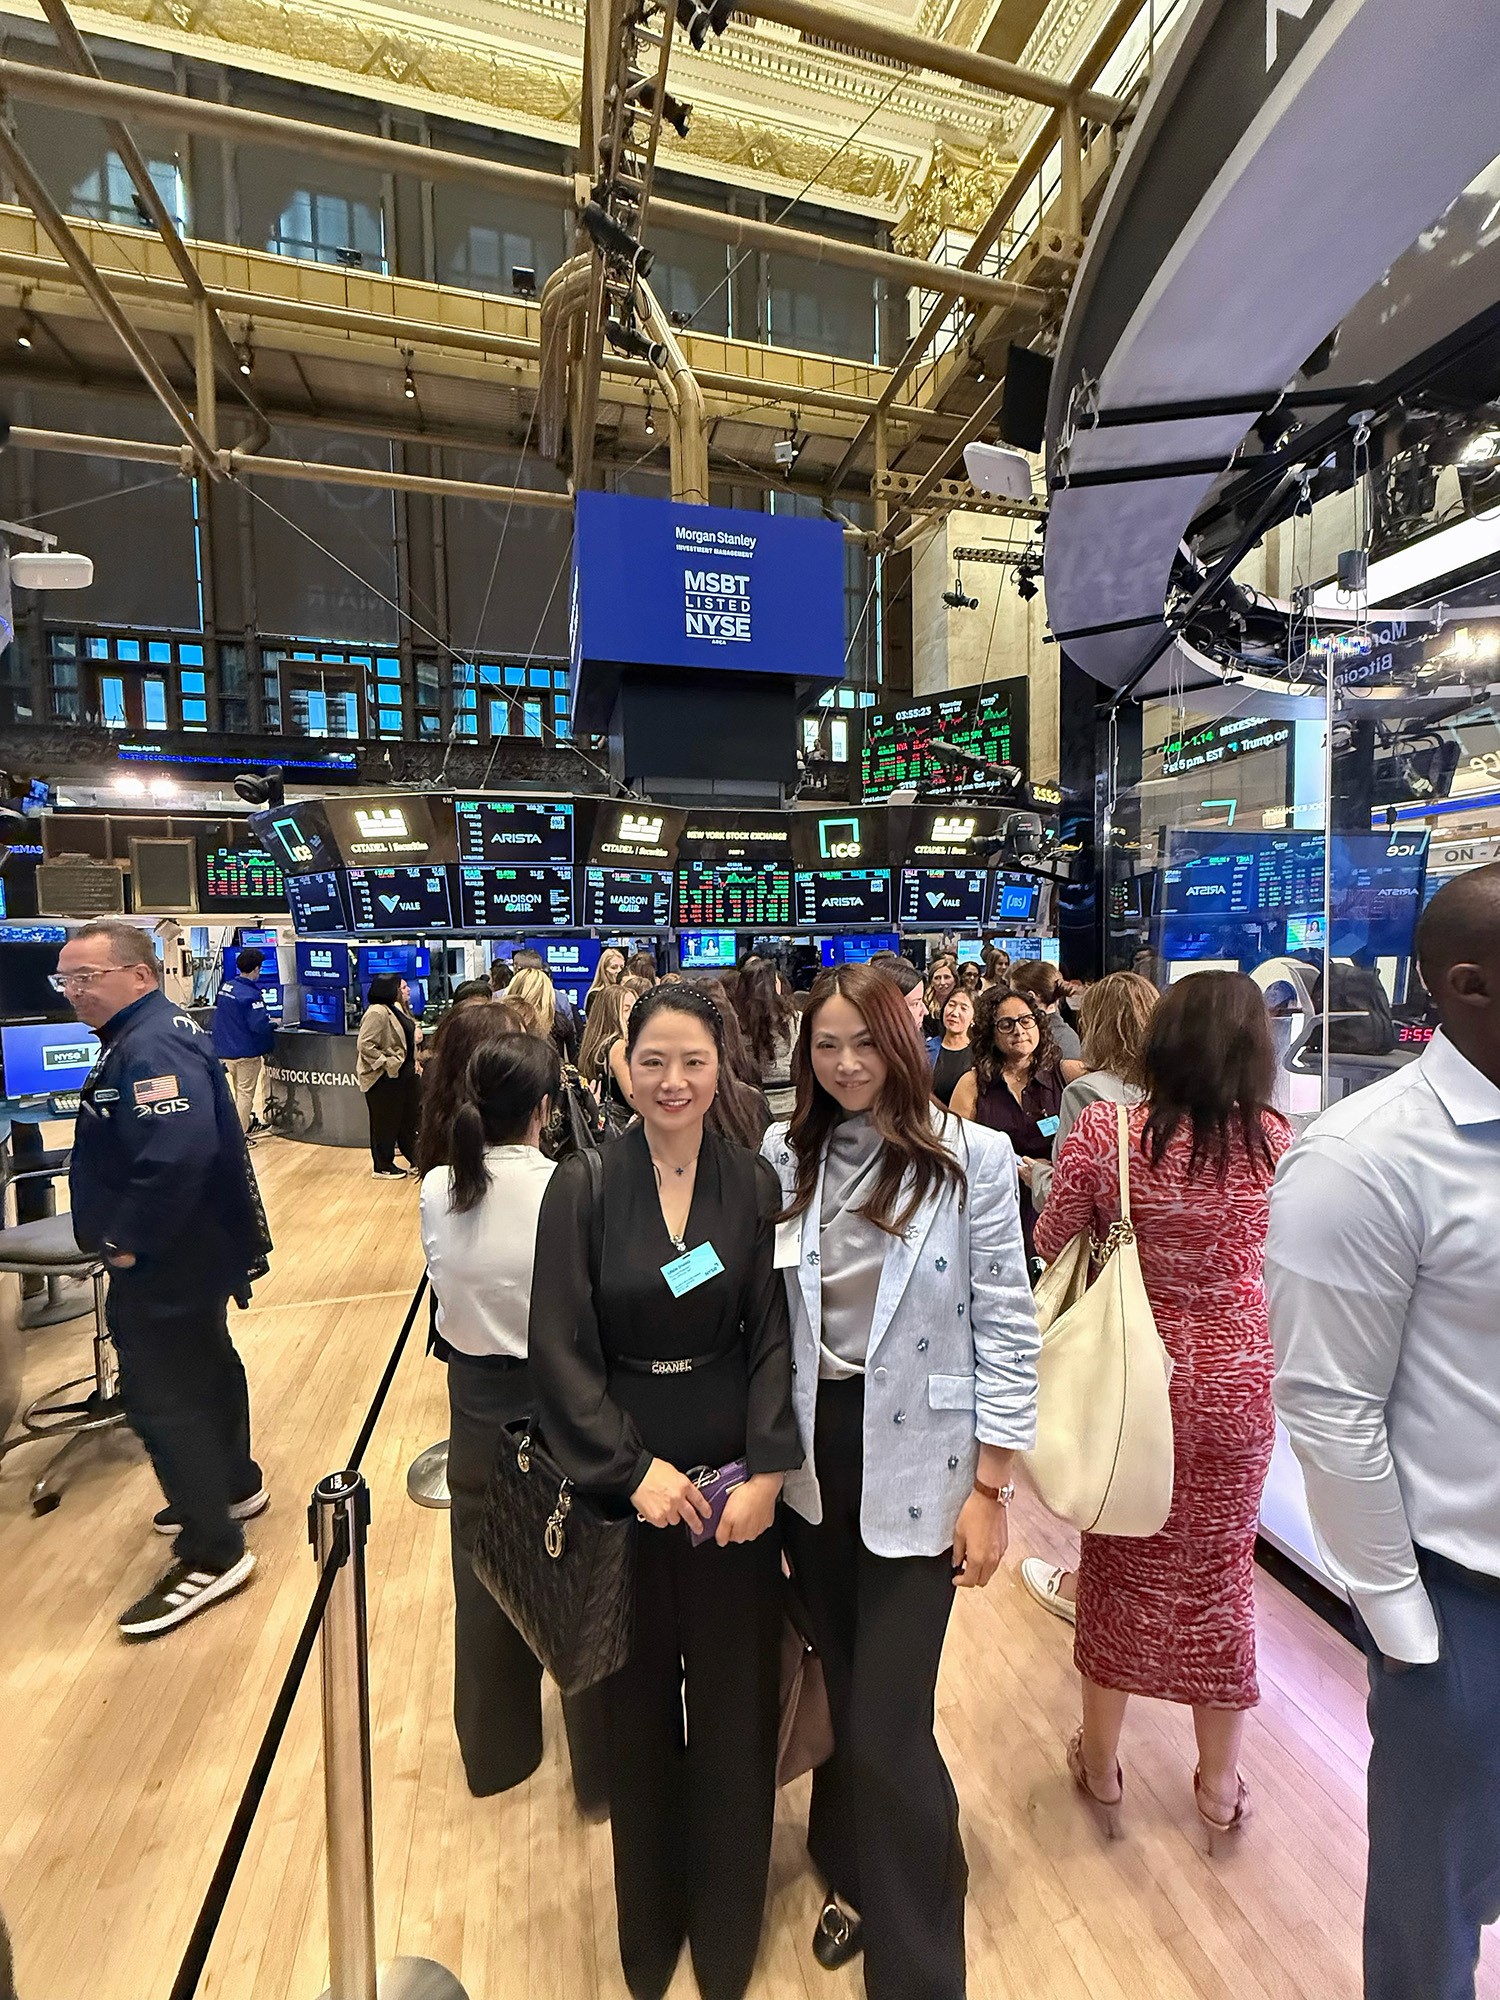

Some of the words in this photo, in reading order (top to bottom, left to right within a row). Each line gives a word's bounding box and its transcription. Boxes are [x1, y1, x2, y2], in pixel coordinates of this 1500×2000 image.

[675, 526, 716, 543] Morgan
[716, 531, 757, 549] Stanley
[676, 544, 713, 554] INVESTMENT
[713, 548, 753, 559] MANAGEMENT
[684, 569, 750, 595] MSBT
[685, 595, 750, 612] LISTED
[686, 612, 751, 638] NYSE
[896, 706, 932, 721] 03:55:23
[1206, 747, 1224, 762] EST
[1240, 733, 1274, 752] Trump
[1274, 729, 1289, 742] on
[491, 833, 542, 844] ARISTA
[686, 831, 705, 839] NEW
[705, 831, 725, 839] YORK
[725, 832, 750, 840] STOCK
[749, 832, 788, 840] EXCHANGE
[351, 843, 388, 853] CITADEL
[601, 843, 635, 855] CITADEL
[493, 894, 542, 903] MADISON
[610, 895, 648, 905] MADISON
[821, 897, 864, 907] ARISTA
[942, 899, 961, 907] VALE
[399, 902, 421, 911] VALE
[281, 1070, 310, 1084] STOCK
[312, 1071, 361, 1086] EXCHAN
[153, 1097, 191, 1115] GTS
[652, 1360, 693, 1374] CHANEL
